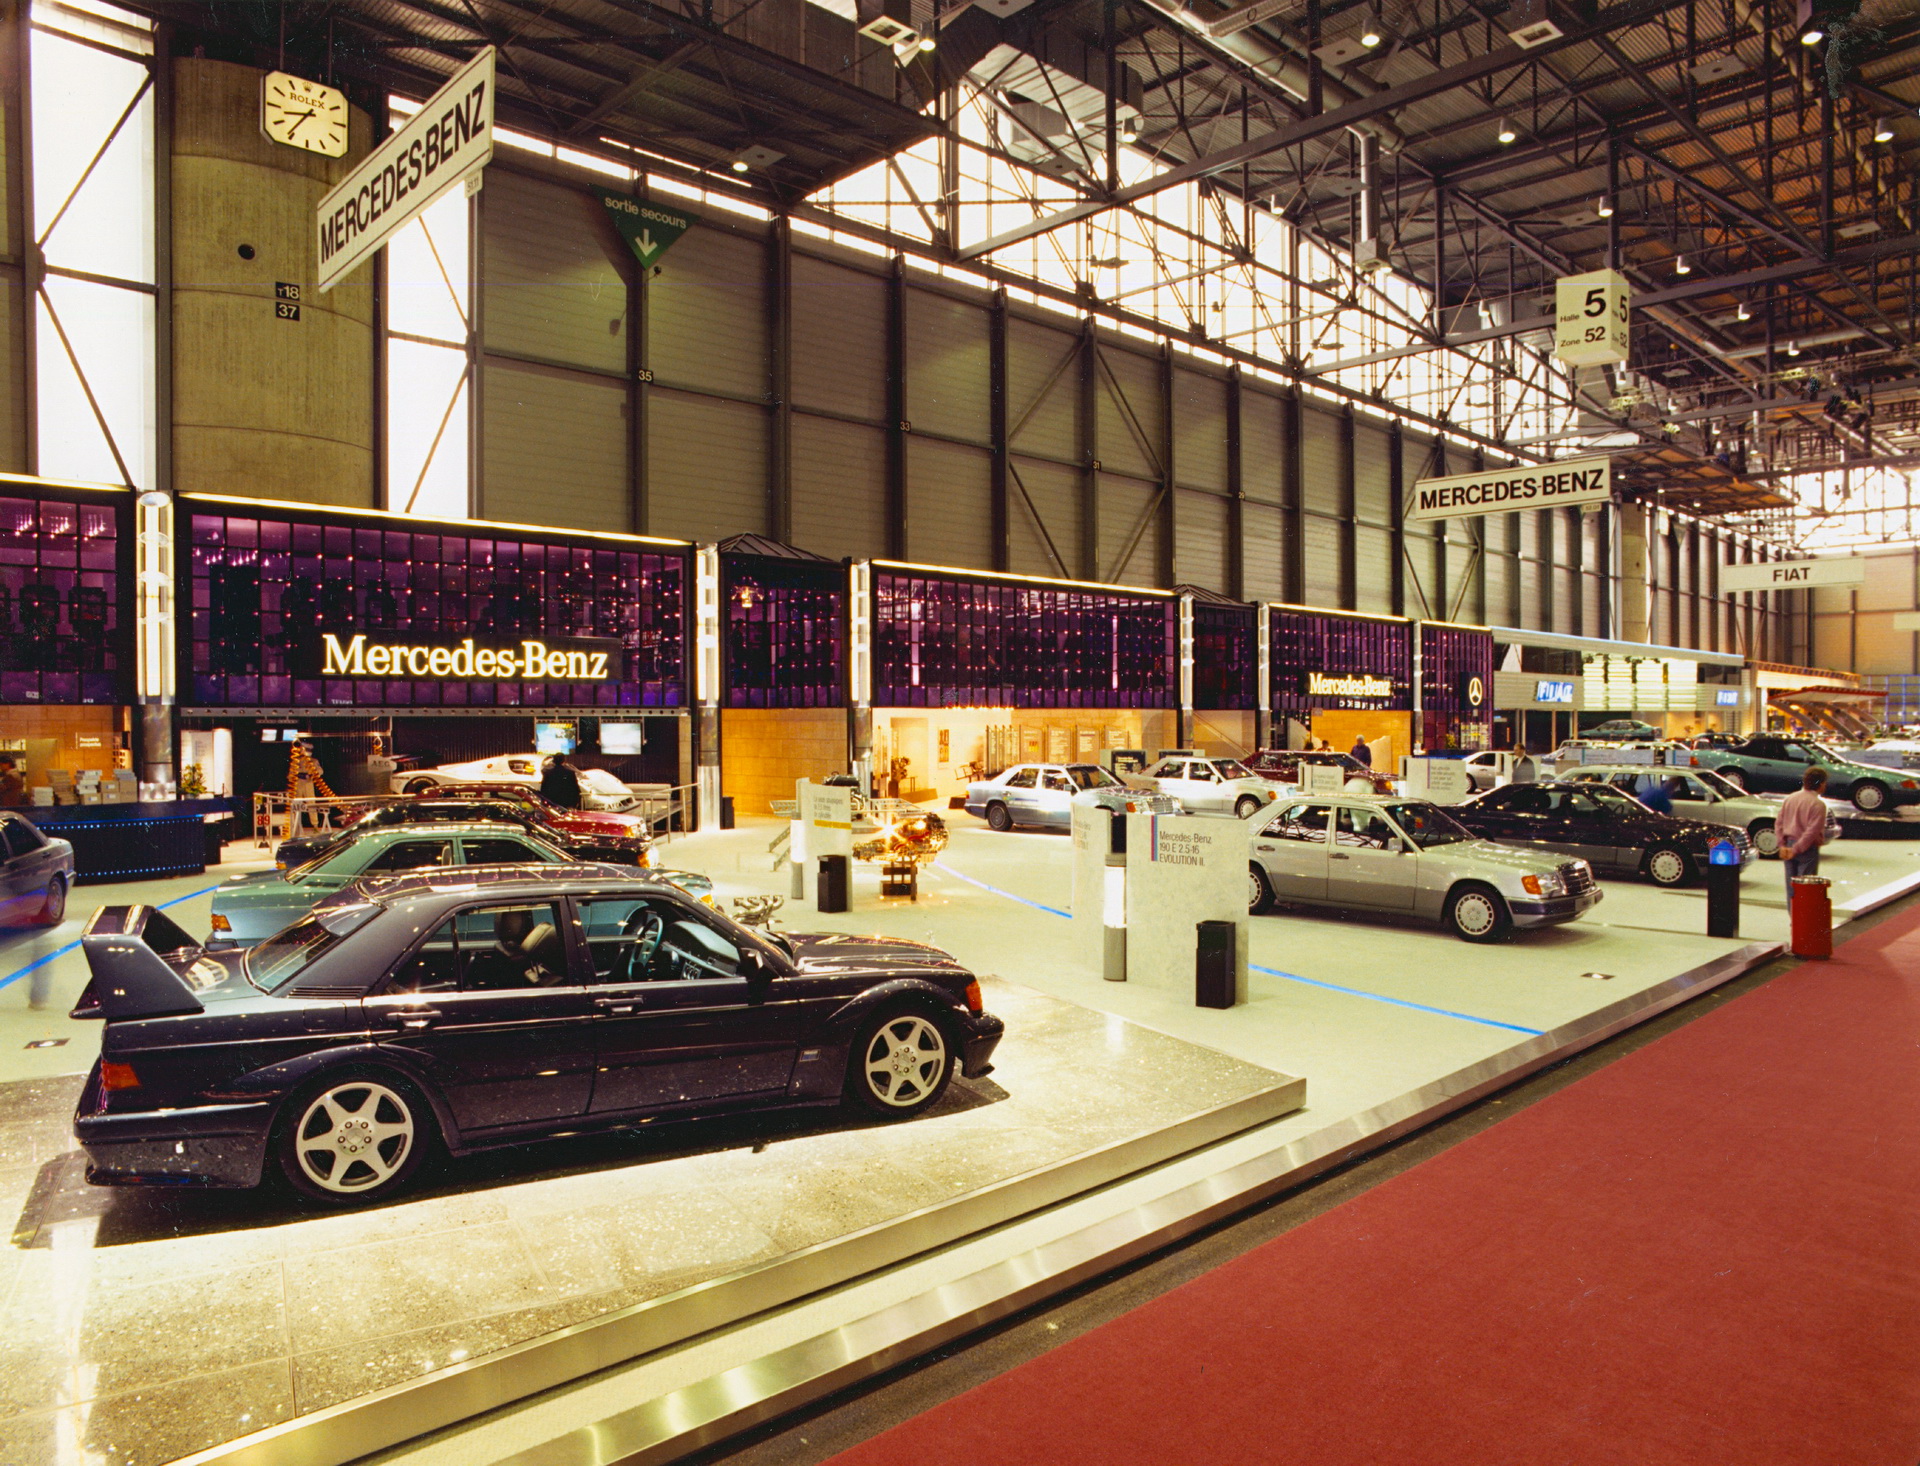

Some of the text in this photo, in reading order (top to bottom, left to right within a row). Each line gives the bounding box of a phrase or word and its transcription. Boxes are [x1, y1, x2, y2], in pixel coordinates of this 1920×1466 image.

[290, 92, 325, 109] ROLEX
[321, 80, 485, 264] MERCEDES-BENZ
[605, 197, 686, 230] sortie secours
[278, 304, 297, 318] 37
[1560, 288, 1607, 322] Halle 5
[1619, 295, 1628, 323] 5
[1560, 339, 1580, 347] Zone
[1584, 326, 1606, 343] 52
[638, 370, 652, 381] 35
[900, 421, 910, 431] 33
[1092, 460, 1100, 470] 31
[1420, 469, 1604, 510] MERCEDES-BENZ
[1773, 567, 1811, 582] FIAT
[322, 634, 608, 679] Mercedes-Benz
[1309, 672, 1391, 696] Mercedes-Benz
[256, 815, 270, 825] 89
[1159, 831, 1212, 844] Mercedes-Benz
[1159, 842, 1200, 855] 190 E 2.5-16
[1159, 854, 1198, 866] EVOLUTION
